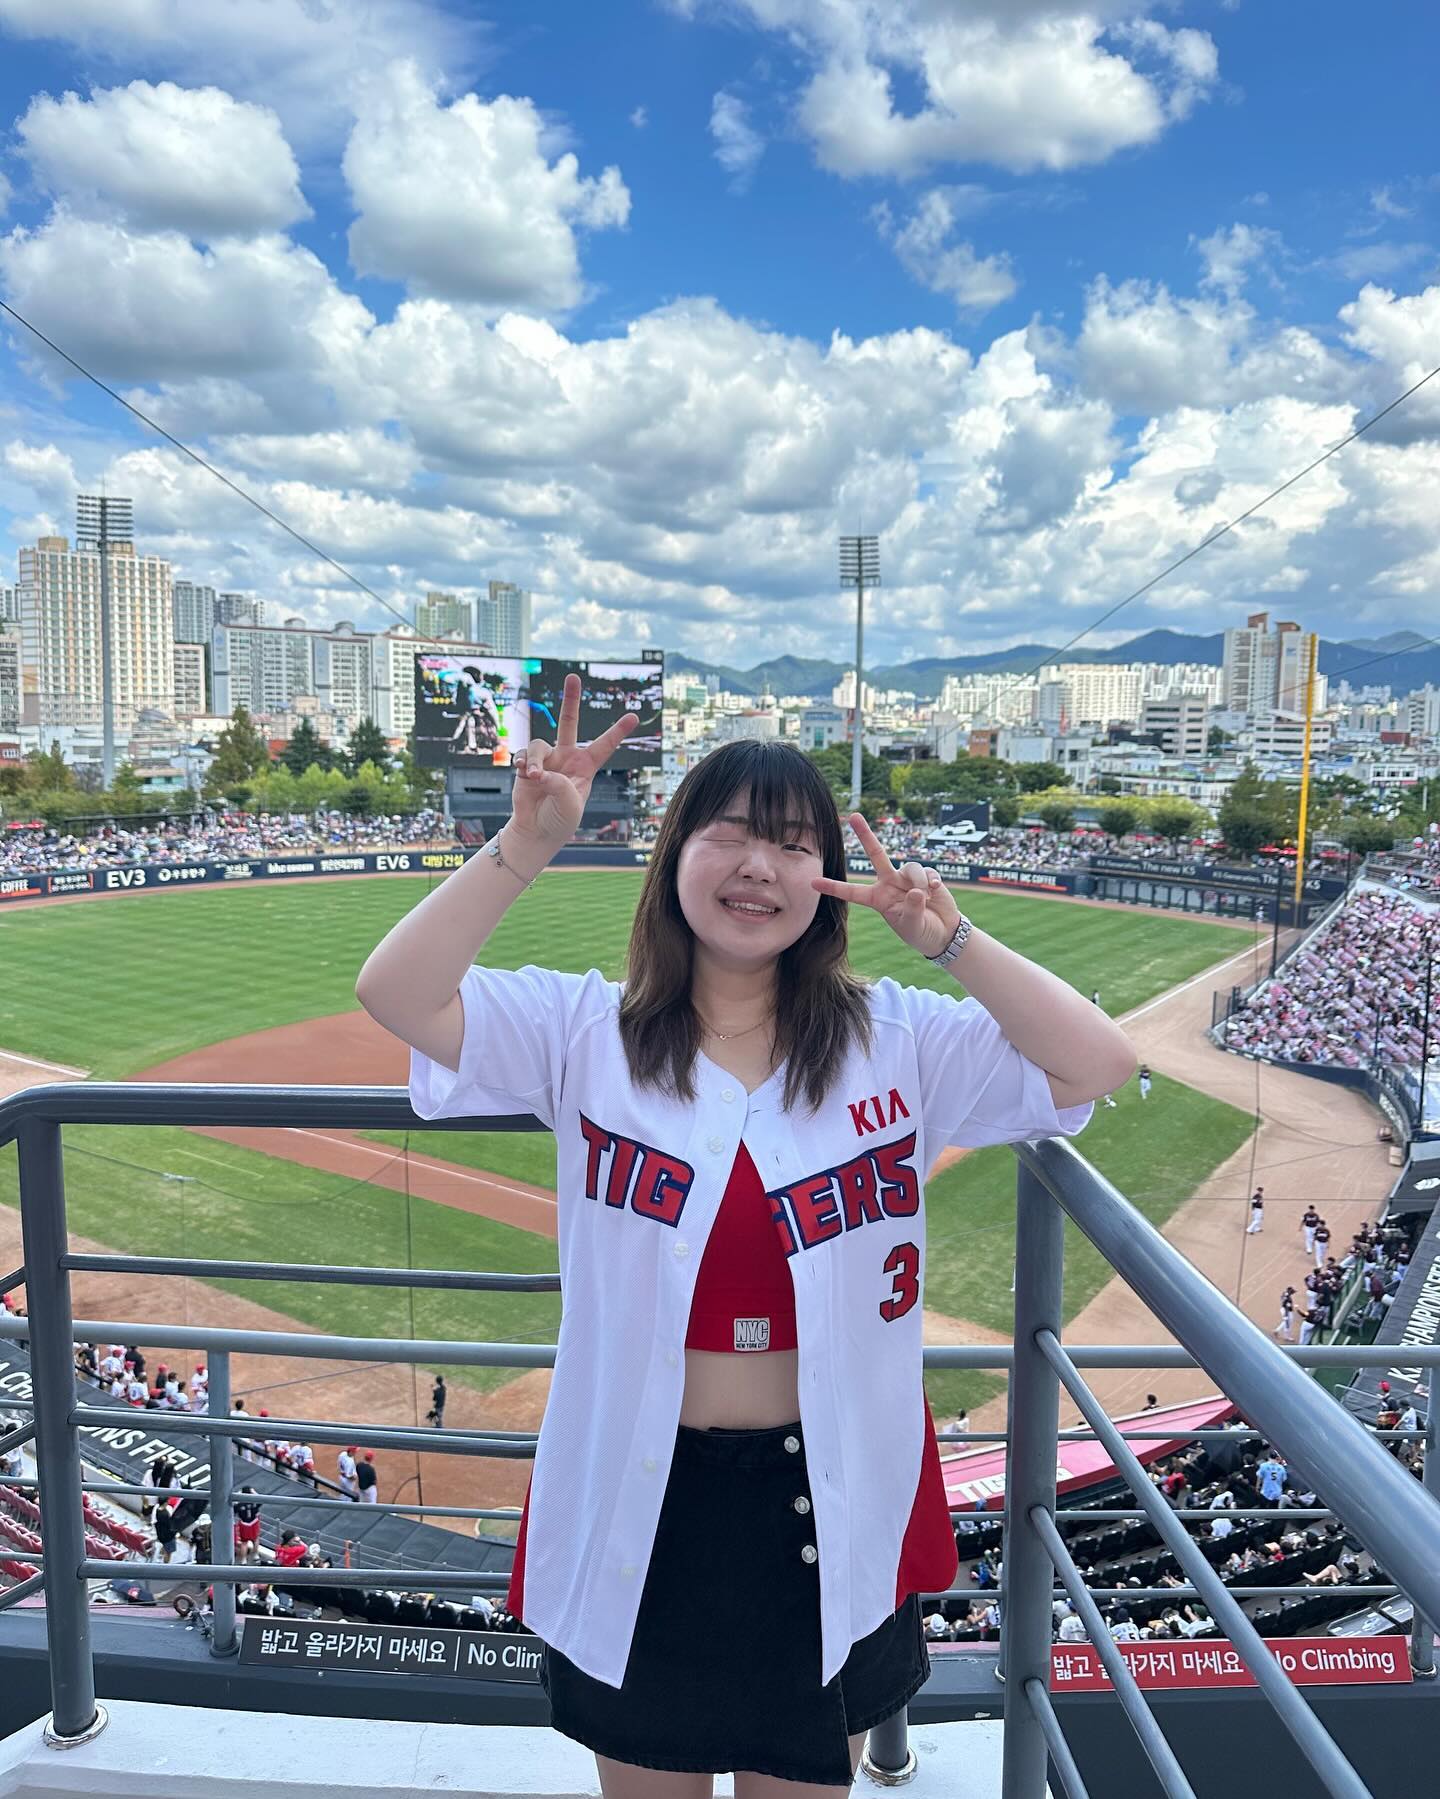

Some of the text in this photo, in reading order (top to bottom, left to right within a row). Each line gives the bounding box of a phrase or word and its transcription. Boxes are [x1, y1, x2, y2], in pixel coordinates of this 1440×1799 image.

[376, 855, 410, 870] EV6
[1142, 860, 1159, 871] The
[1161, 864, 1180, 874] new
[1181, 863, 1196, 874] K5
[106, 869, 146, 888] EV3
[1305, 880, 1322, 890] K5
[847, 1088, 911, 1137] KIA
[879, 1241, 920, 1323] 3
[736, 1320, 769, 1342] NYC
[260, 1629, 299, 1655] 밟고
[305, 1632, 382, 1661] 올라가지
[388, 1637, 447, 1664] 마세요
[467, 1643, 497, 1666] No
[1053, 1655, 1094, 1680] 밟고
[1183, 1651, 1244, 1675] 마세요
[1301, 1648, 1396, 1674] Climbing
